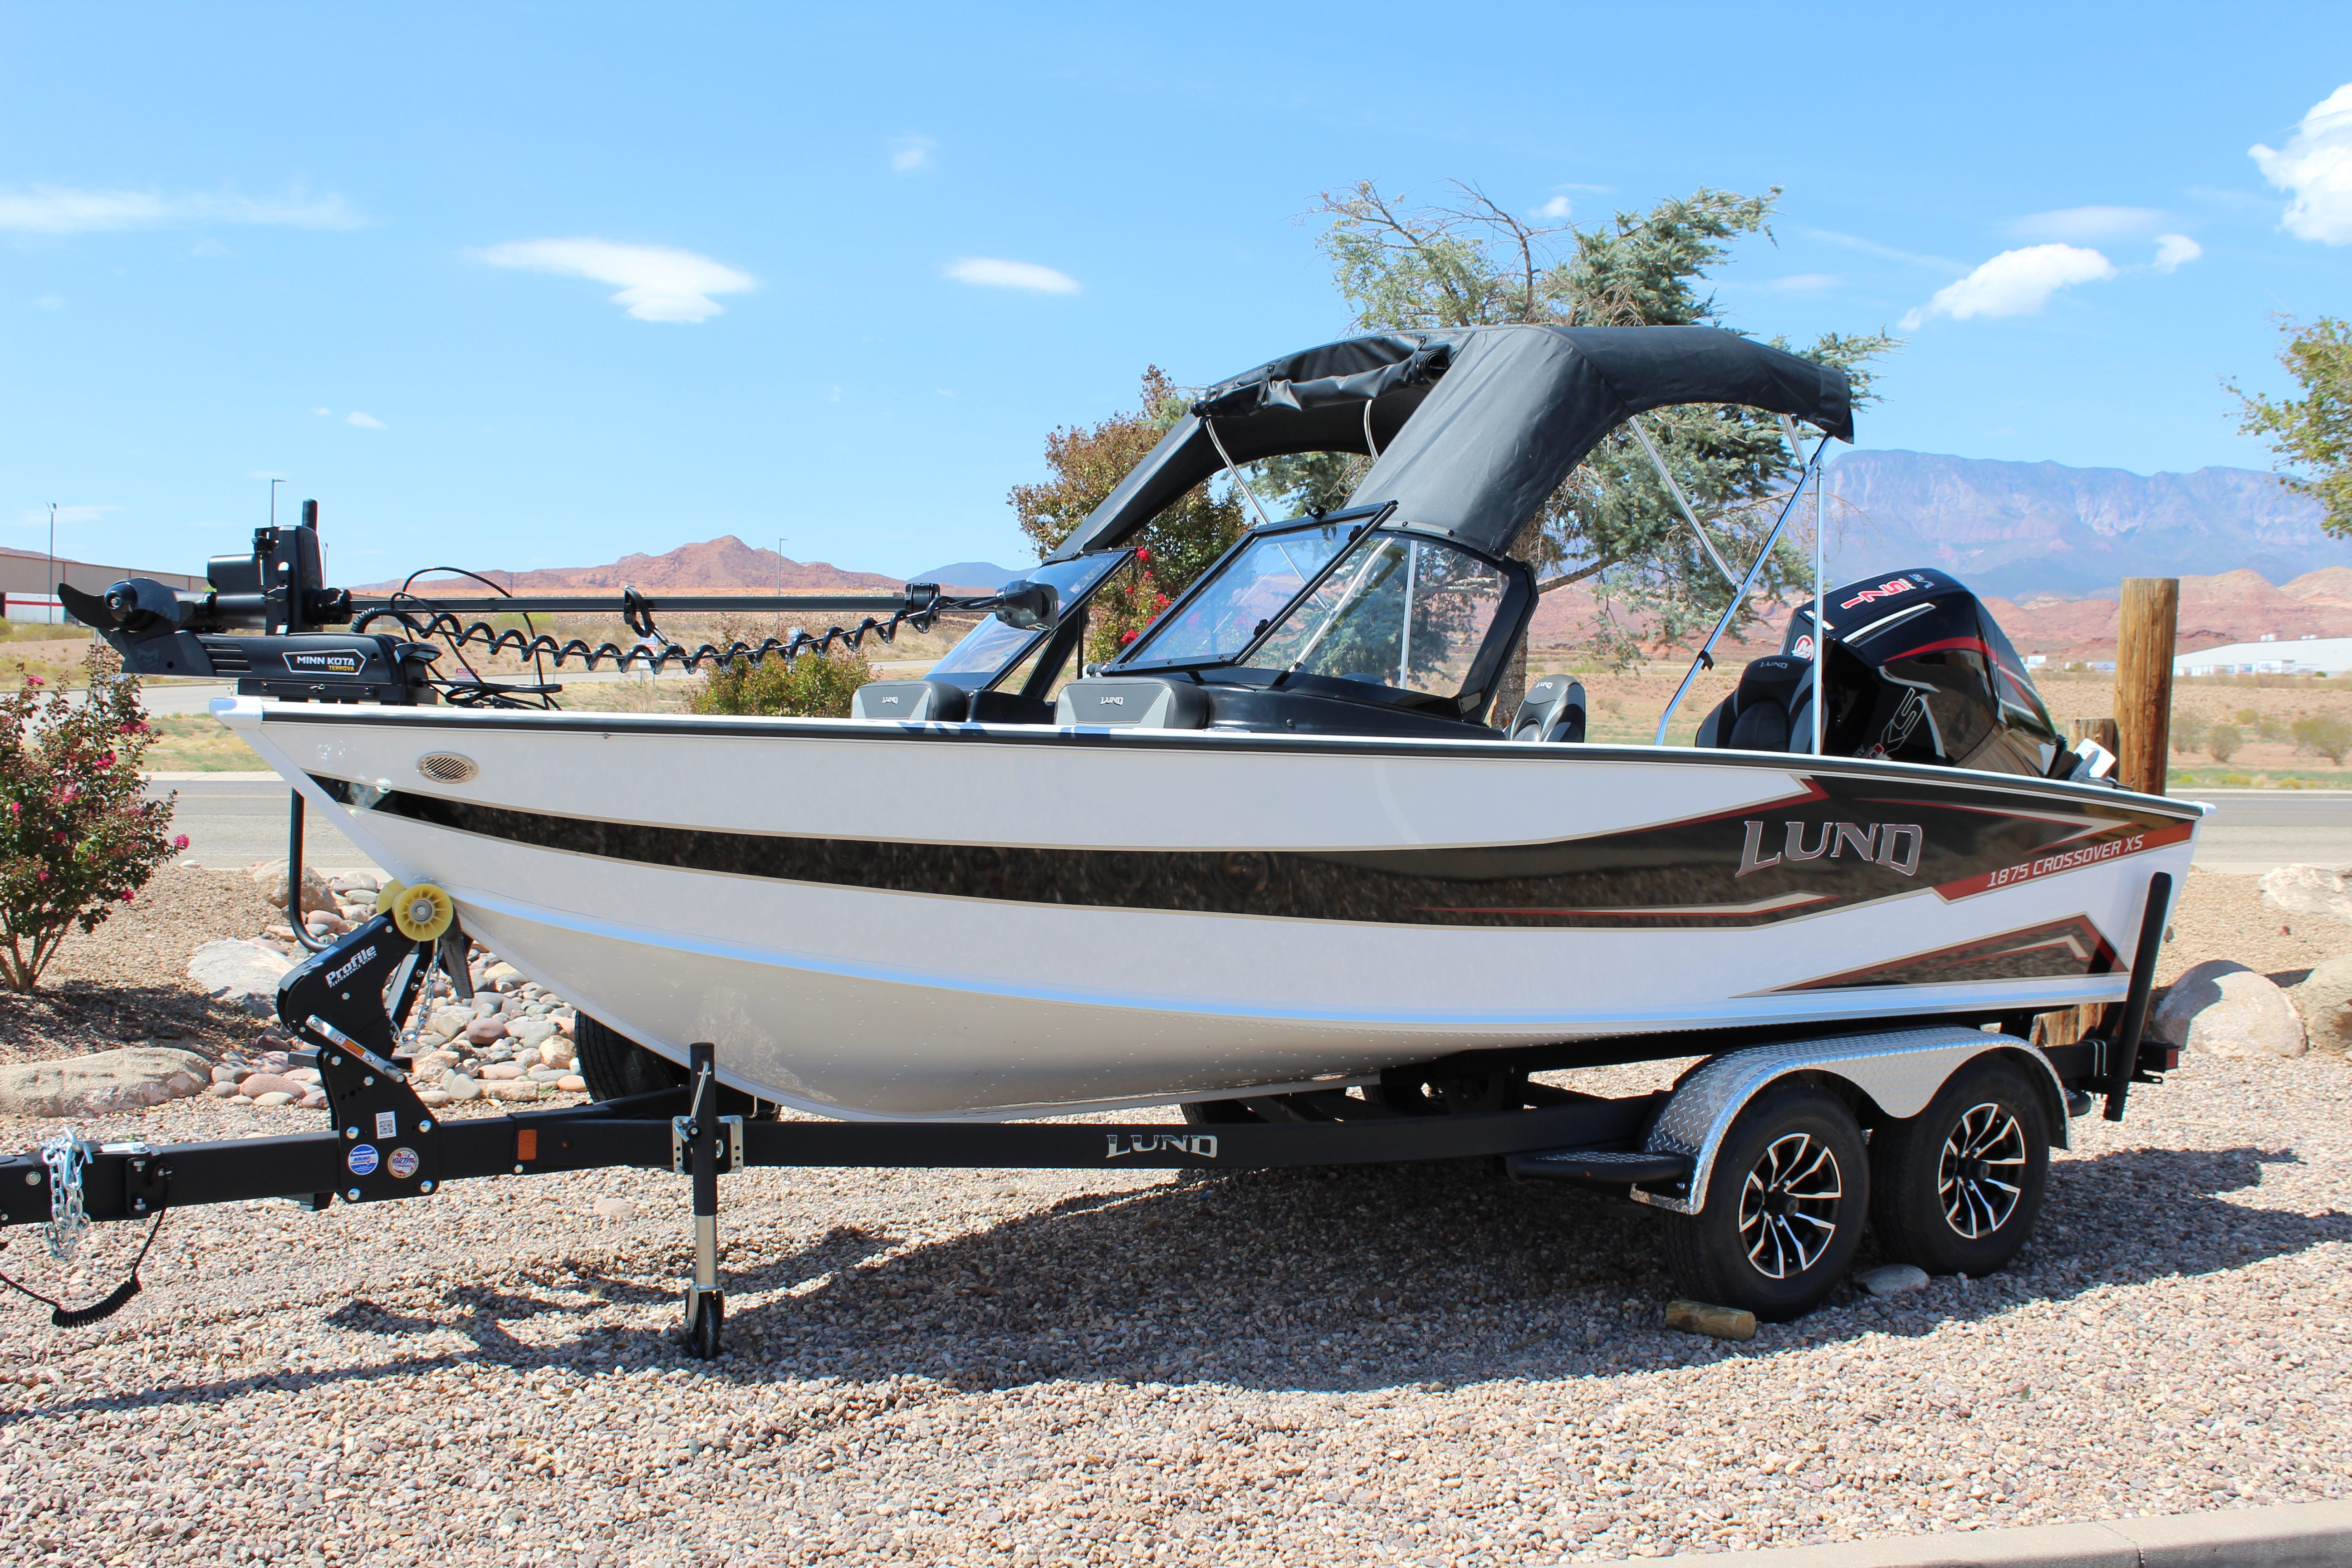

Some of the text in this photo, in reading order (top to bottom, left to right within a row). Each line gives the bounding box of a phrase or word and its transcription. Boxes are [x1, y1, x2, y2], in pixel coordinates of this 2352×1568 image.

[1840, 580, 1910, 610] 175
[296, 656, 355, 666] MINN KOTA
[1100, 696, 1123, 706] LUND
[1735, 821, 1923, 878] LUND
[1987, 834, 2145, 887] 1875 CROSSOVER XS
[325, 946, 376, 985] Profile
[330, 953, 377, 988] PERFORMANCE WINCH
[1106, 1135, 1217, 1158] LUND
